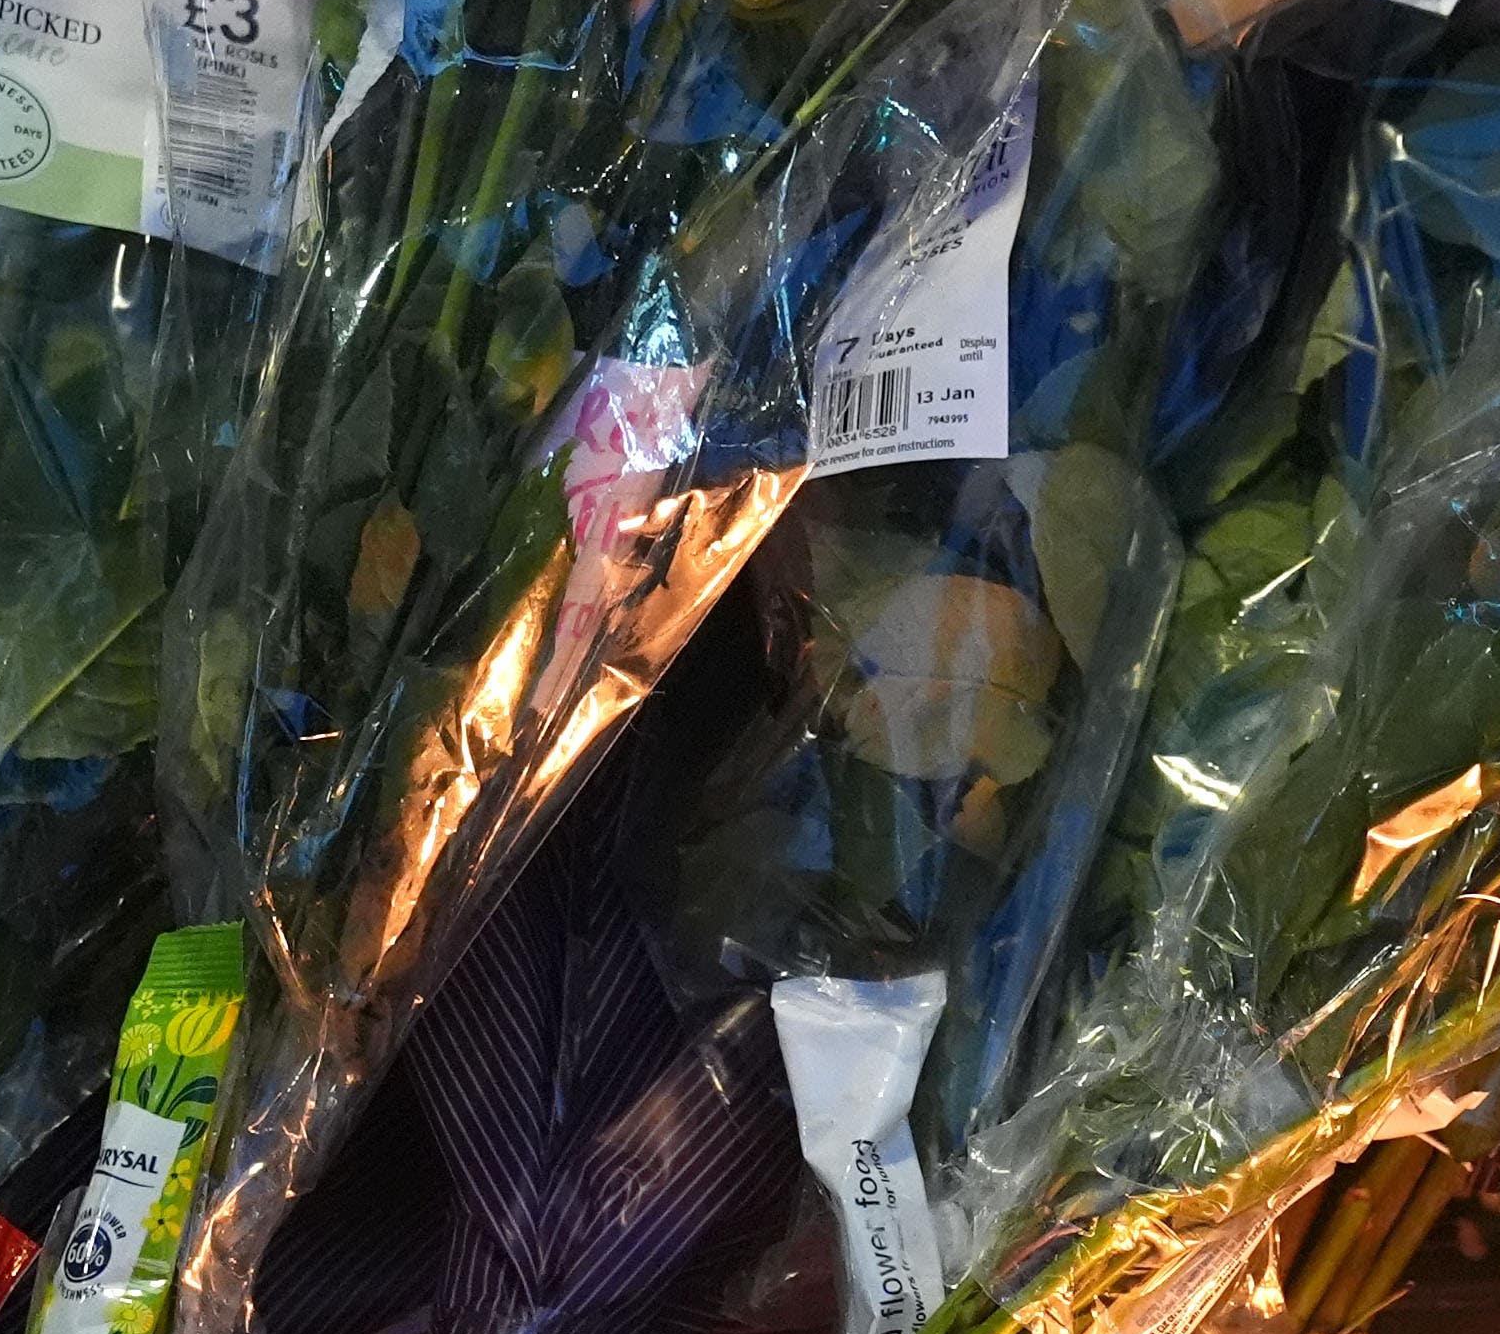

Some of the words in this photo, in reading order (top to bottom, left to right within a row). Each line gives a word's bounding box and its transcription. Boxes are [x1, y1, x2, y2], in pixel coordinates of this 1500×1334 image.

[3, 32, 70, 68] care
[225, 43, 279, 69] ROSES
[13, 124, 44, 141] DAYS
[871, 326, 917, 347] Days
[959, 336, 997, 351] Display
[835, 336, 861, 366] 7
[959, 349, 984, 363] until
[916, 390, 935, 405] 13
[940, 387, 976, 403] Jan
[863, 424, 899, 441] 6528
[861, 445, 875, 459] for
[876, 445, 897, 457] care
[897, 438, 956, 454] instructions
[851, 1139, 880, 1210] food
[67, 1239, 105, 1269] 60%
[871, 1225, 905, 1319] flower
